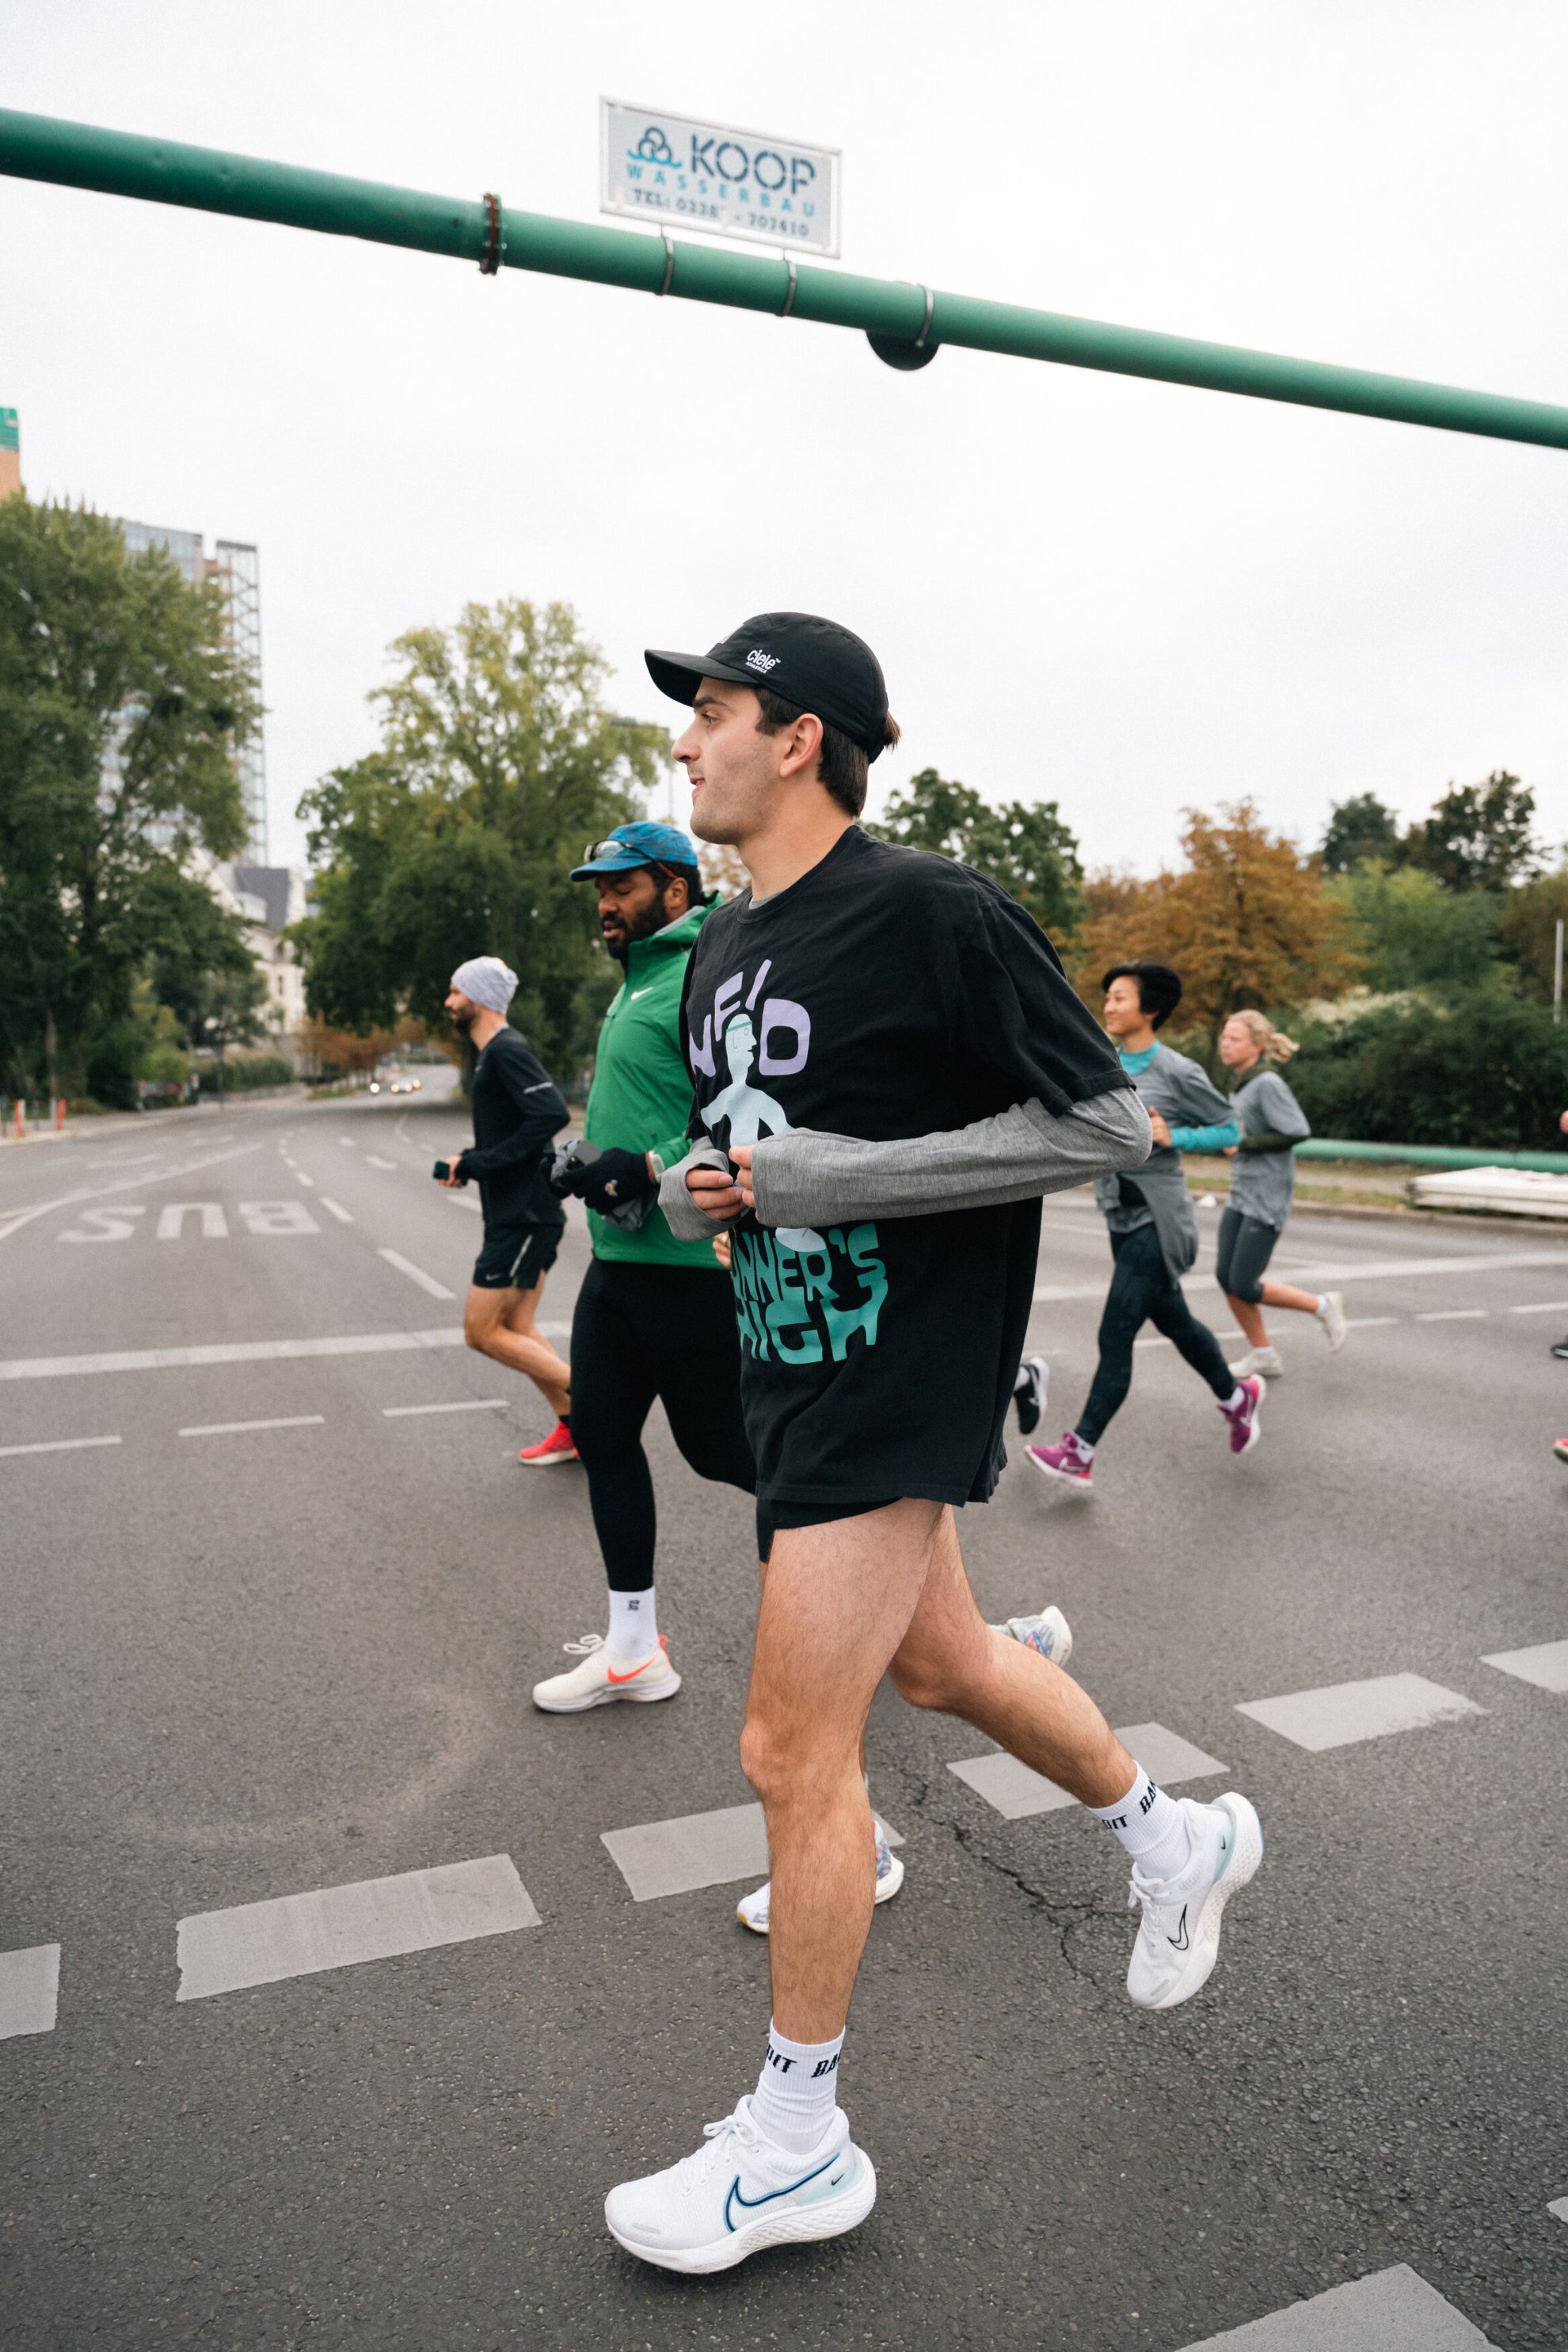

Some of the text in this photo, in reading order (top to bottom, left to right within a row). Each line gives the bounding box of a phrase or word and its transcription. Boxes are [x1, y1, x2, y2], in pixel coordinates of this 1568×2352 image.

[626, 163, 815, 217] WASSERBAU
[691, 134, 815, 195] KOOP
[55, 1200, 322, 1243] BUS
